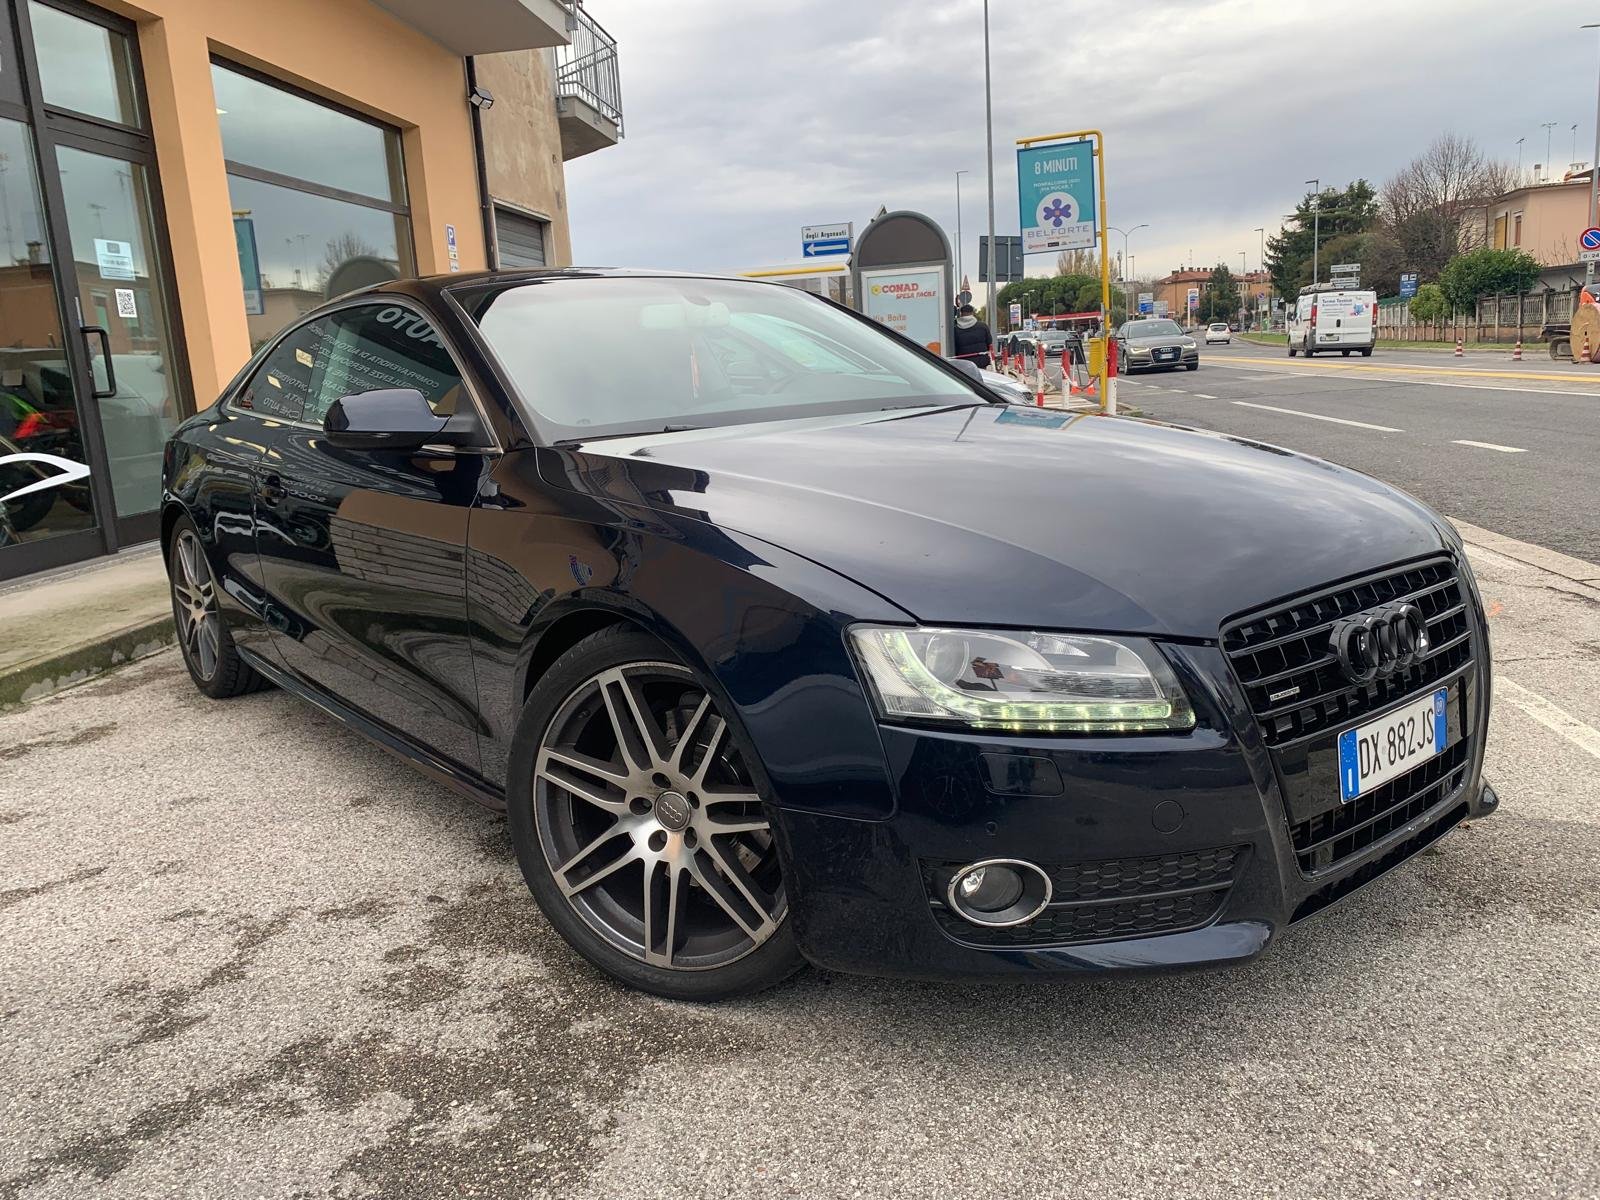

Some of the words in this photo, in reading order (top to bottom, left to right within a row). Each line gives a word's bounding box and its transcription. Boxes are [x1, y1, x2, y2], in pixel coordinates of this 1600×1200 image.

[1034, 161, 1041, 175] 8
[1043, 157, 1078, 174] MINUTI
[1027, 224, 1089, 238] BELFORTE
[882, 283, 919, 293] CONAD
[916, 290, 937, 298] FACILE
[1359, 731, 1381, 779] DX
